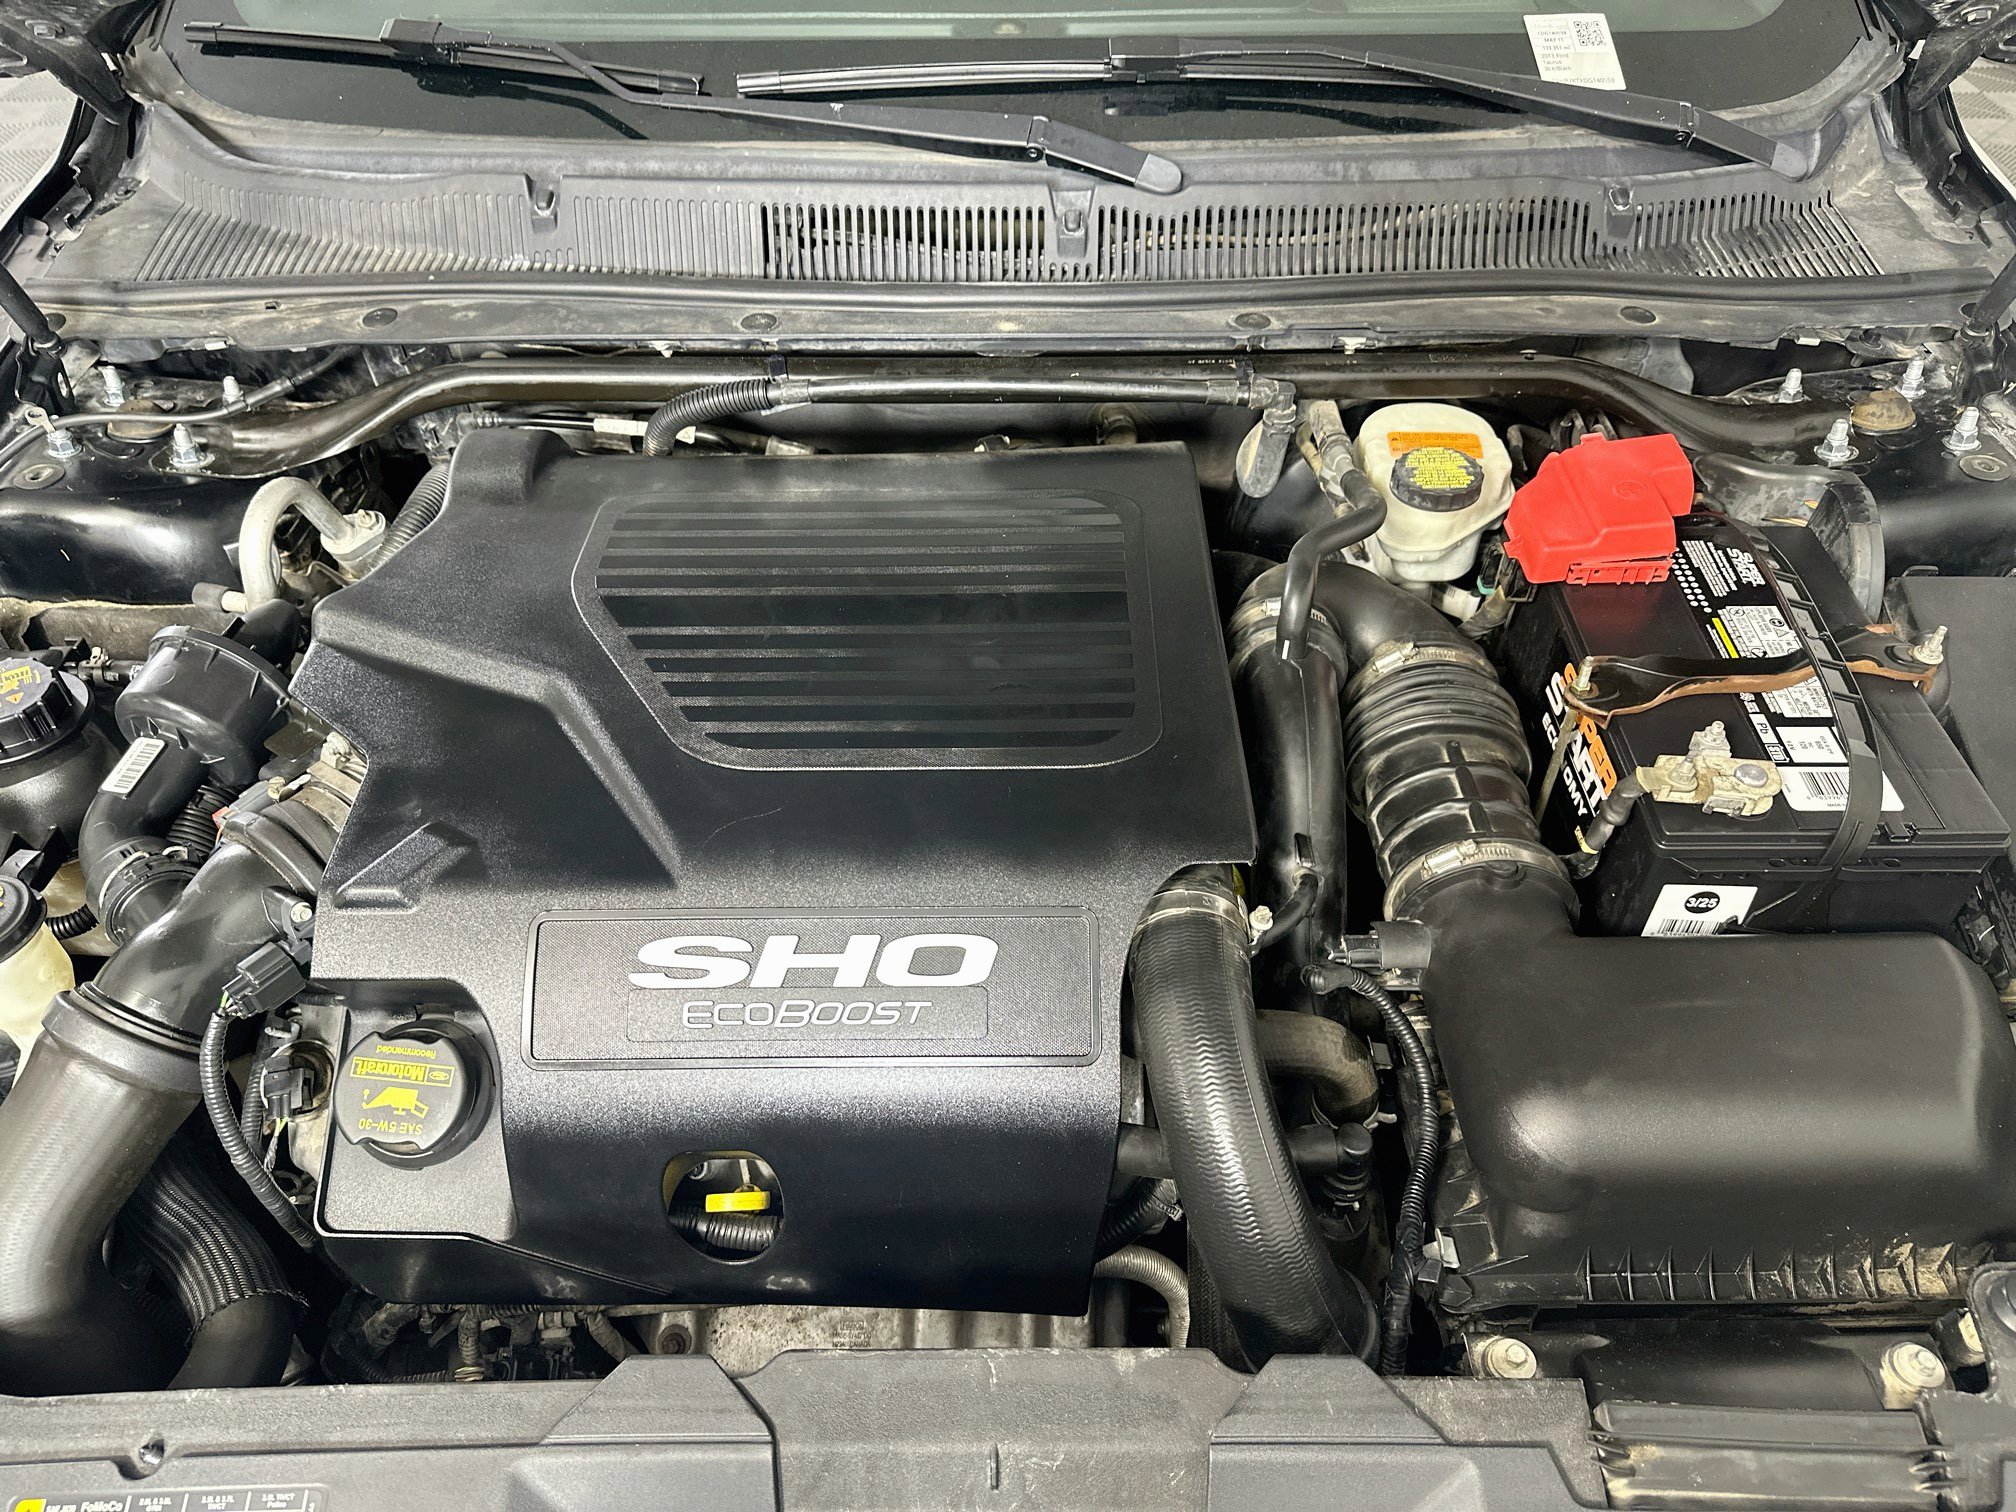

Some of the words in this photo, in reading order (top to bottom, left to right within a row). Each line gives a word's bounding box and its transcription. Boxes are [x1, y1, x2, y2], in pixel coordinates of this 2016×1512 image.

[1743, 552, 1766, 586] SUPER
[1560, 662, 1617, 797] SPER
[1757, 722, 1769, 734] Pb
[1545, 671, 1608, 808] SART
[1542, 711, 1588, 817] ECOMY
[1686, 897, 1719, 908] 3/25
[628, 933, 999, 989] SHO
[376, 1044, 436, 1059] Recommended
[355, 1059, 426, 1082] Motorcraft
[358, 1118, 397, 1133] 5W-30
[400, 1122, 423, 1135] SAE
[80, 1501, 123, 1512] FoMoCo
